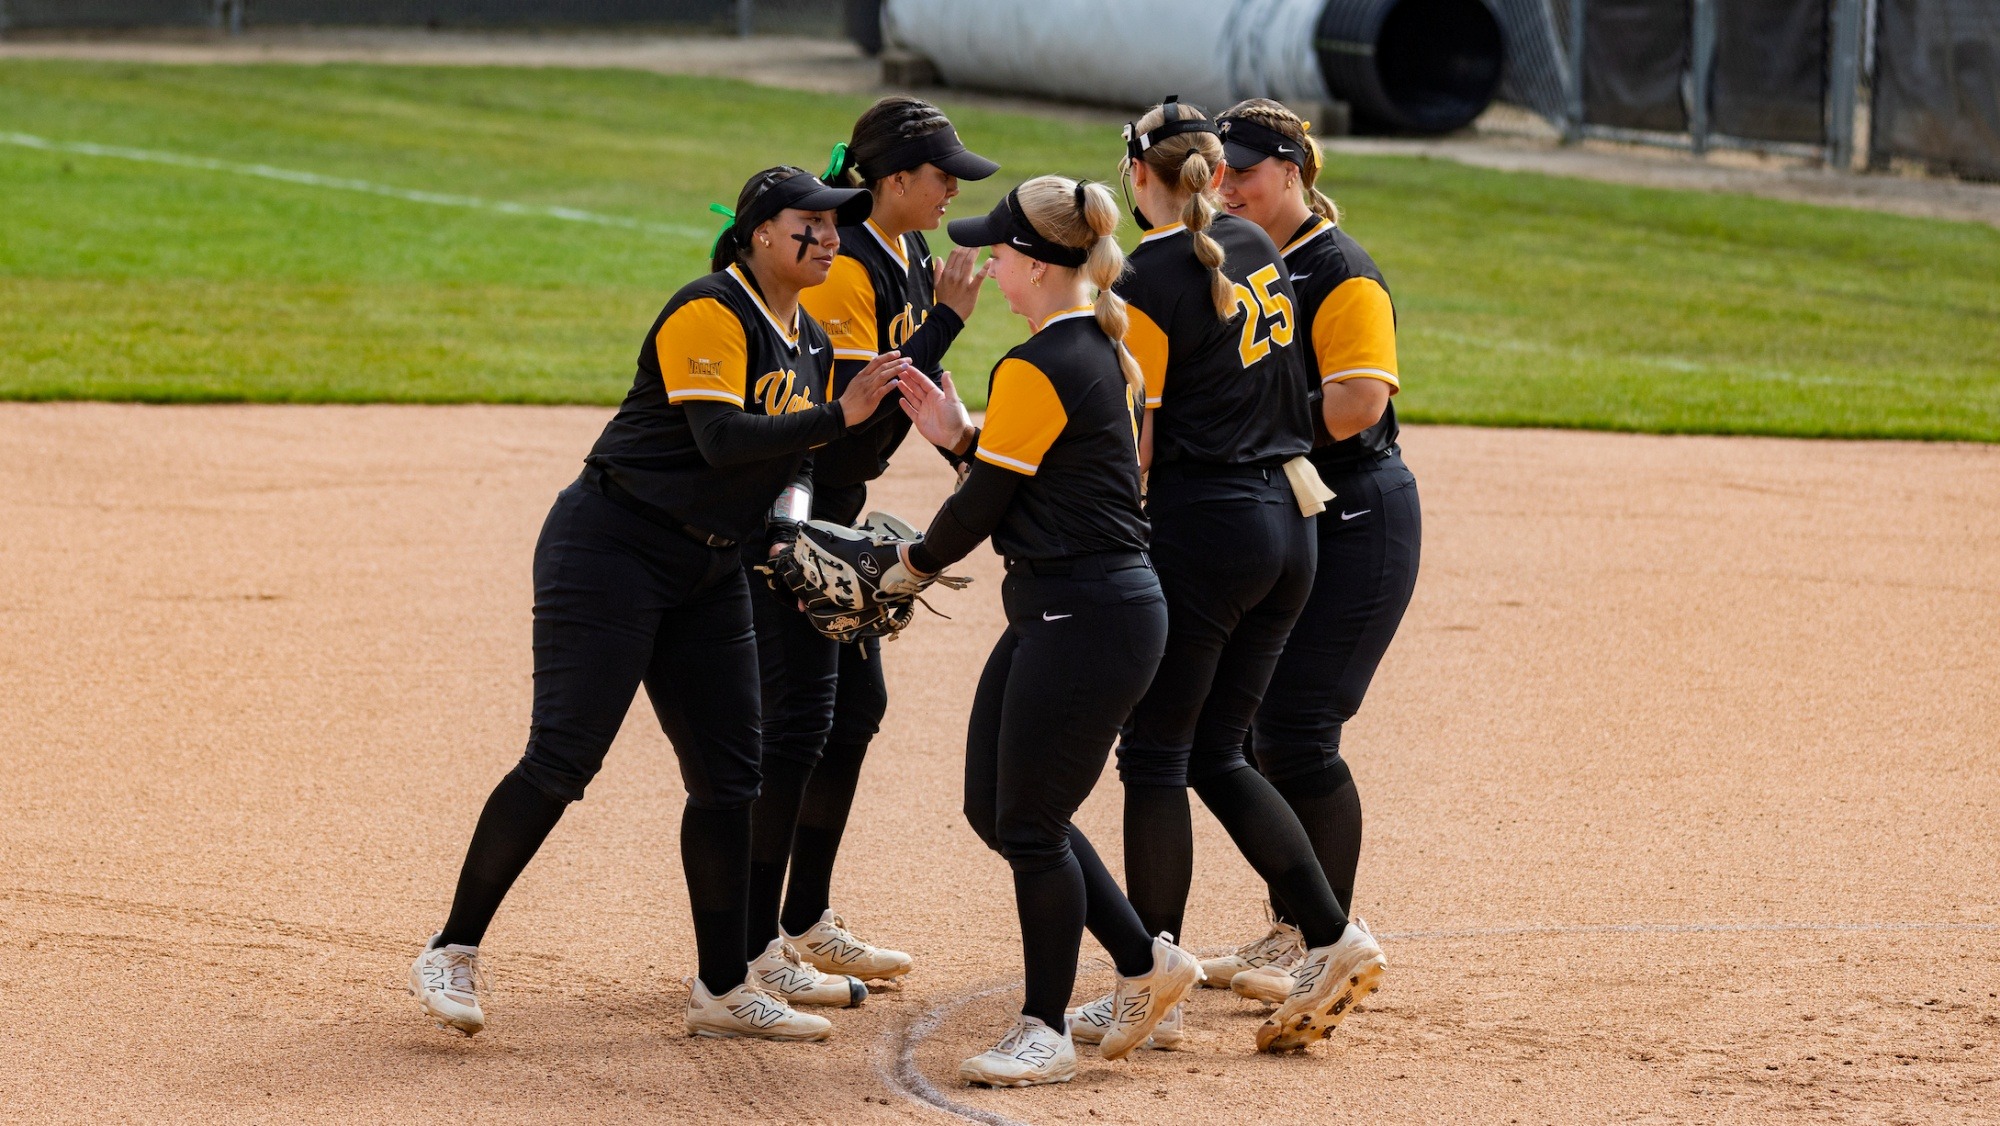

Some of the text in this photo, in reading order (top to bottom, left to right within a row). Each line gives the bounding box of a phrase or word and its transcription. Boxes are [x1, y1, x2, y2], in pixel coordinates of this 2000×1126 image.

[1224, 262, 1294, 369] 25
[812, 937, 865, 965] N
[423, 966, 445, 990] N
[761, 966, 813, 994] N
[731, 1000, 783, 1029] N
[1119, 993, 1150, 1023] N
[1016, 1042, 1056, 1068] N
